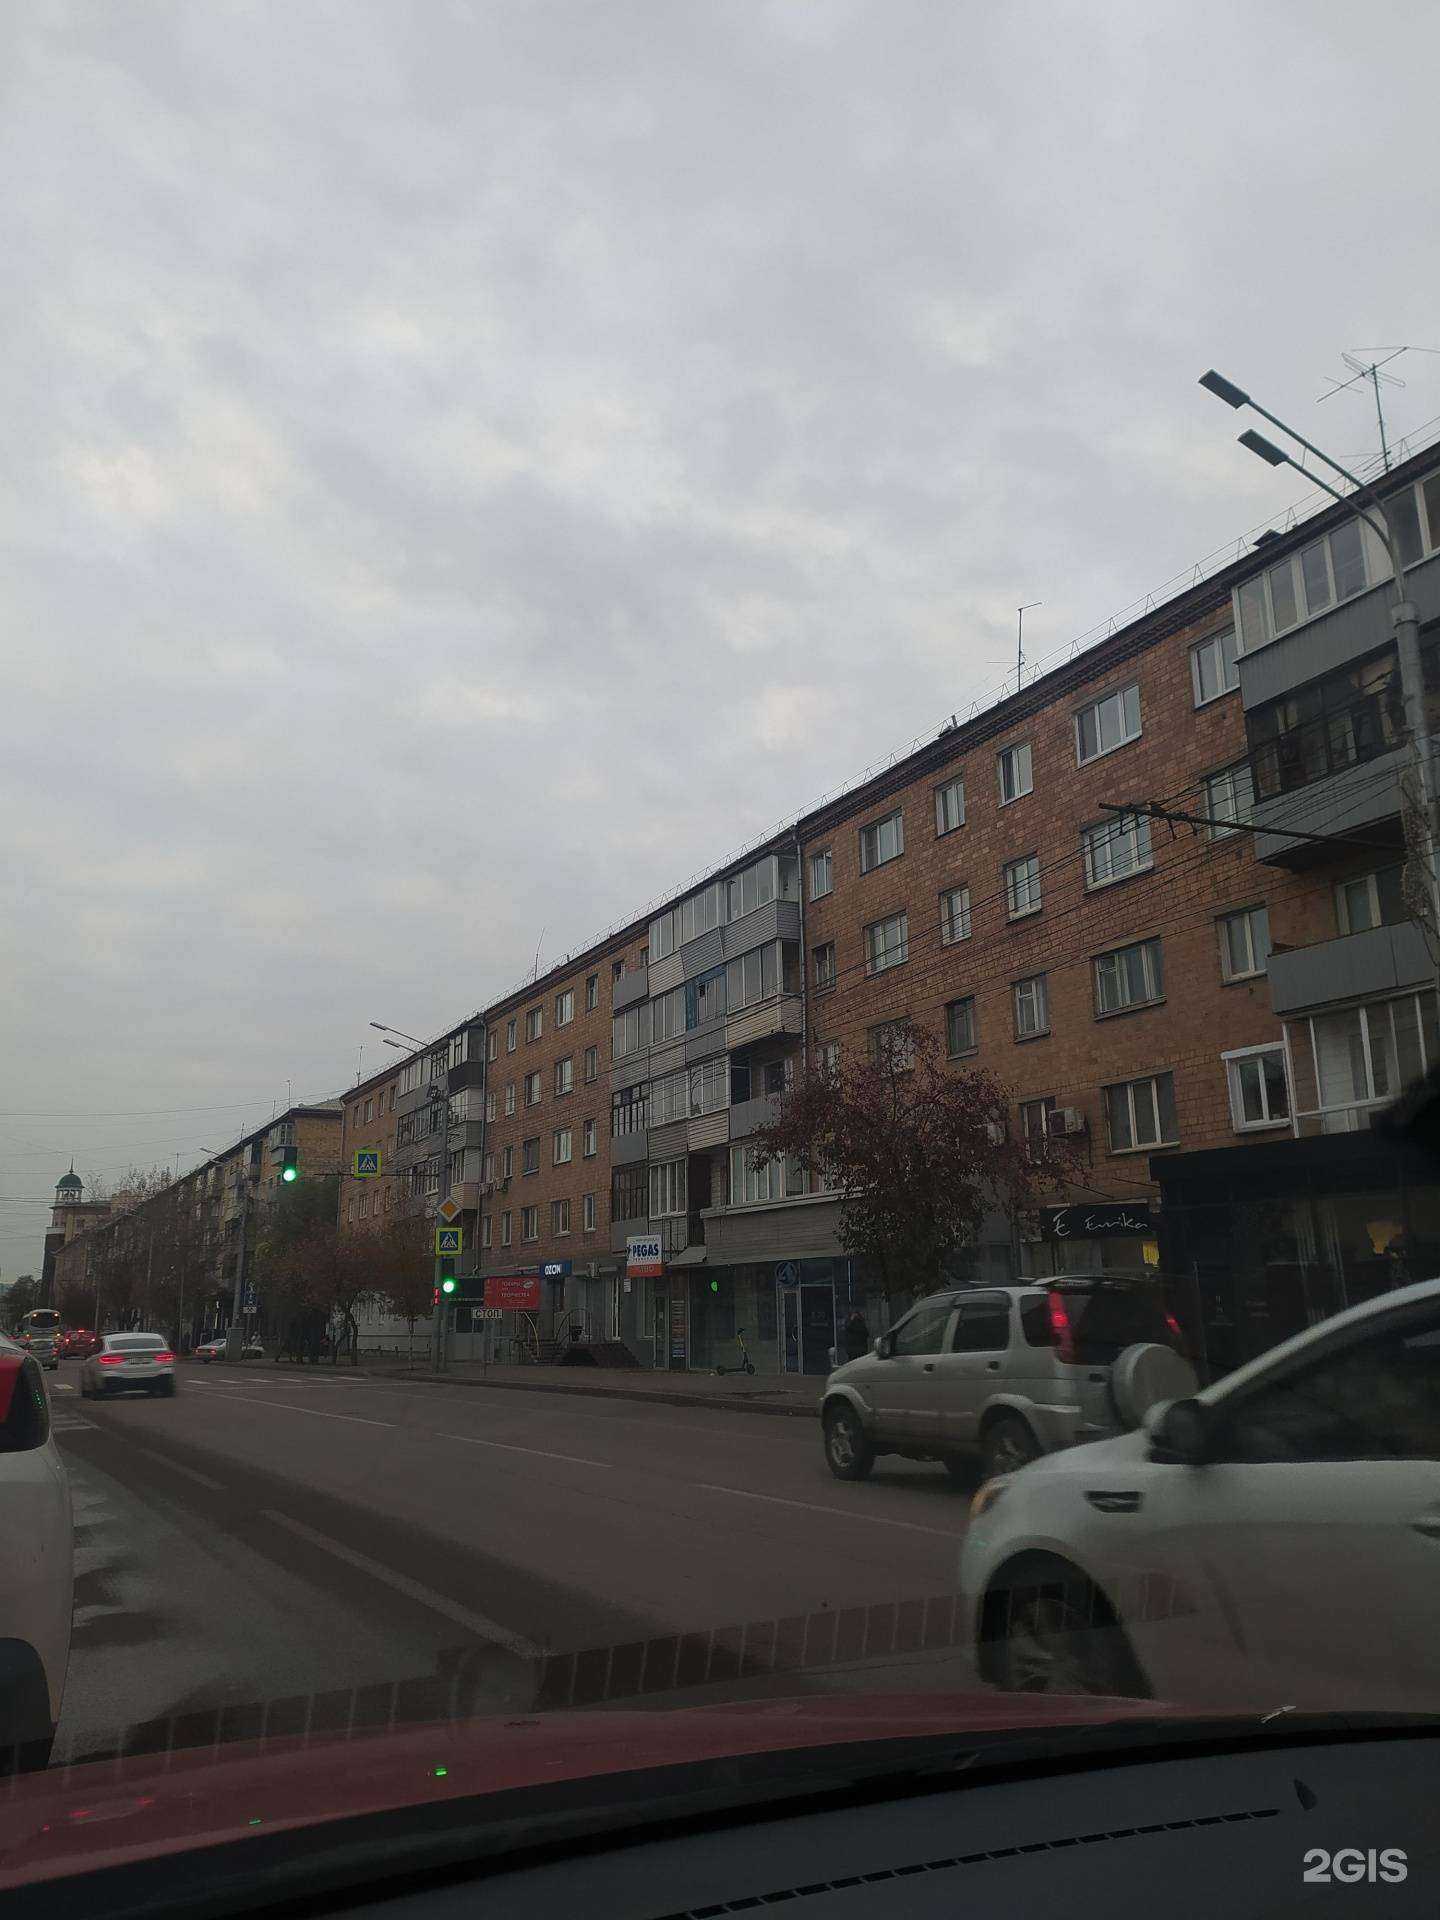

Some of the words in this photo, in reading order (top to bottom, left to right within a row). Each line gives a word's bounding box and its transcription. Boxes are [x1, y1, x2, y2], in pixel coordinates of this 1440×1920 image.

[632, 1243, 659, 1257] PEGAS
[544, 1263, 562, 1276] OZON
[476, 1309, 499, 1318] СТОП
